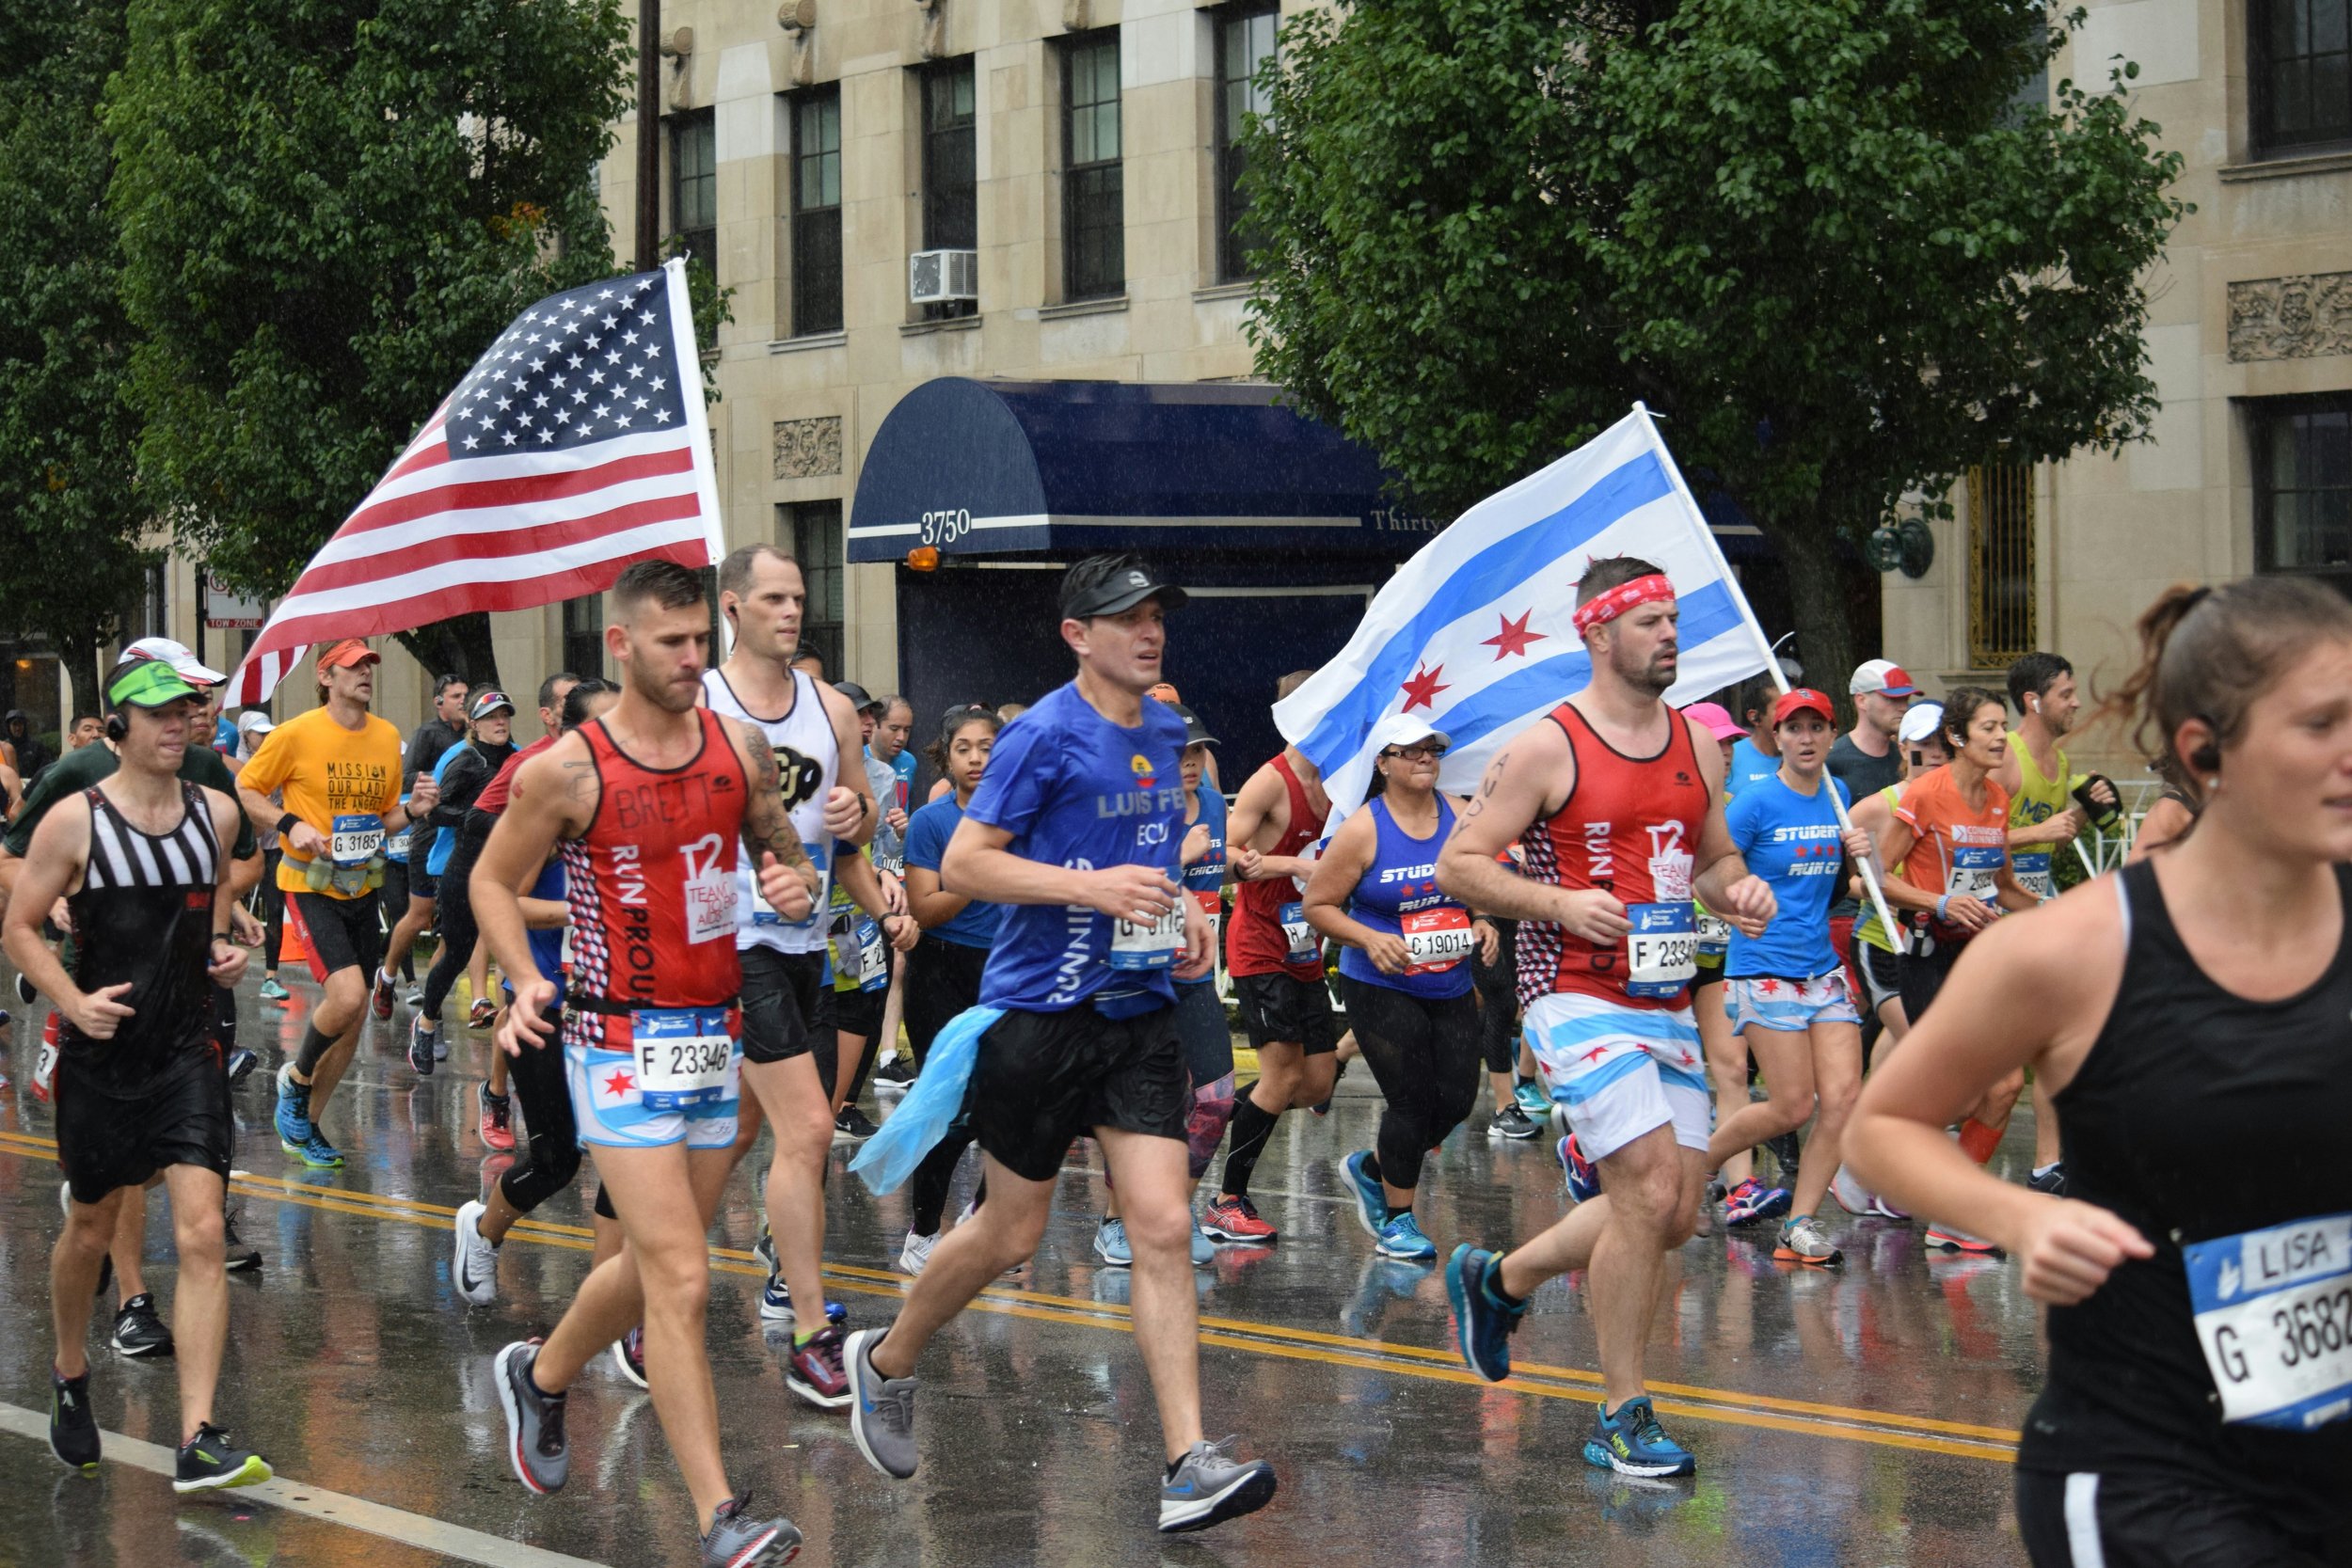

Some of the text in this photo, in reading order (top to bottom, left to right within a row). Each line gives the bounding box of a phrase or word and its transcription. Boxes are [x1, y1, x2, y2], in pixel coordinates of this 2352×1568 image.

[922, 509, 970, 545] 3750
[211, 619, 230, 627] TOW
[328, 780, 387, 799] OUR LADY
[614, 772, 710, 829] BRETT
[1451, 752, 1510, 840] ANDY
[329, 798, 346, 810] THE
[1098, 791, 1152, 818] LUIS
[334, 836, 343, 853] G
[1583, 821, 1614, 877] RUN
[612, 845, 648, 904] RUN
[1951, 872, 1963, 889] F
[1699, 918, 1708, 934] G
[1412, 932, 1470, 956] C 19014
[1635, 942, 1646, 968] F
[862, 953, 871, 973] F
[643, 1043, 729, 1075] F 23346
[2260, 1231, 2332, 1278] LISA
[2215, 1323, 2251, 1384] G
